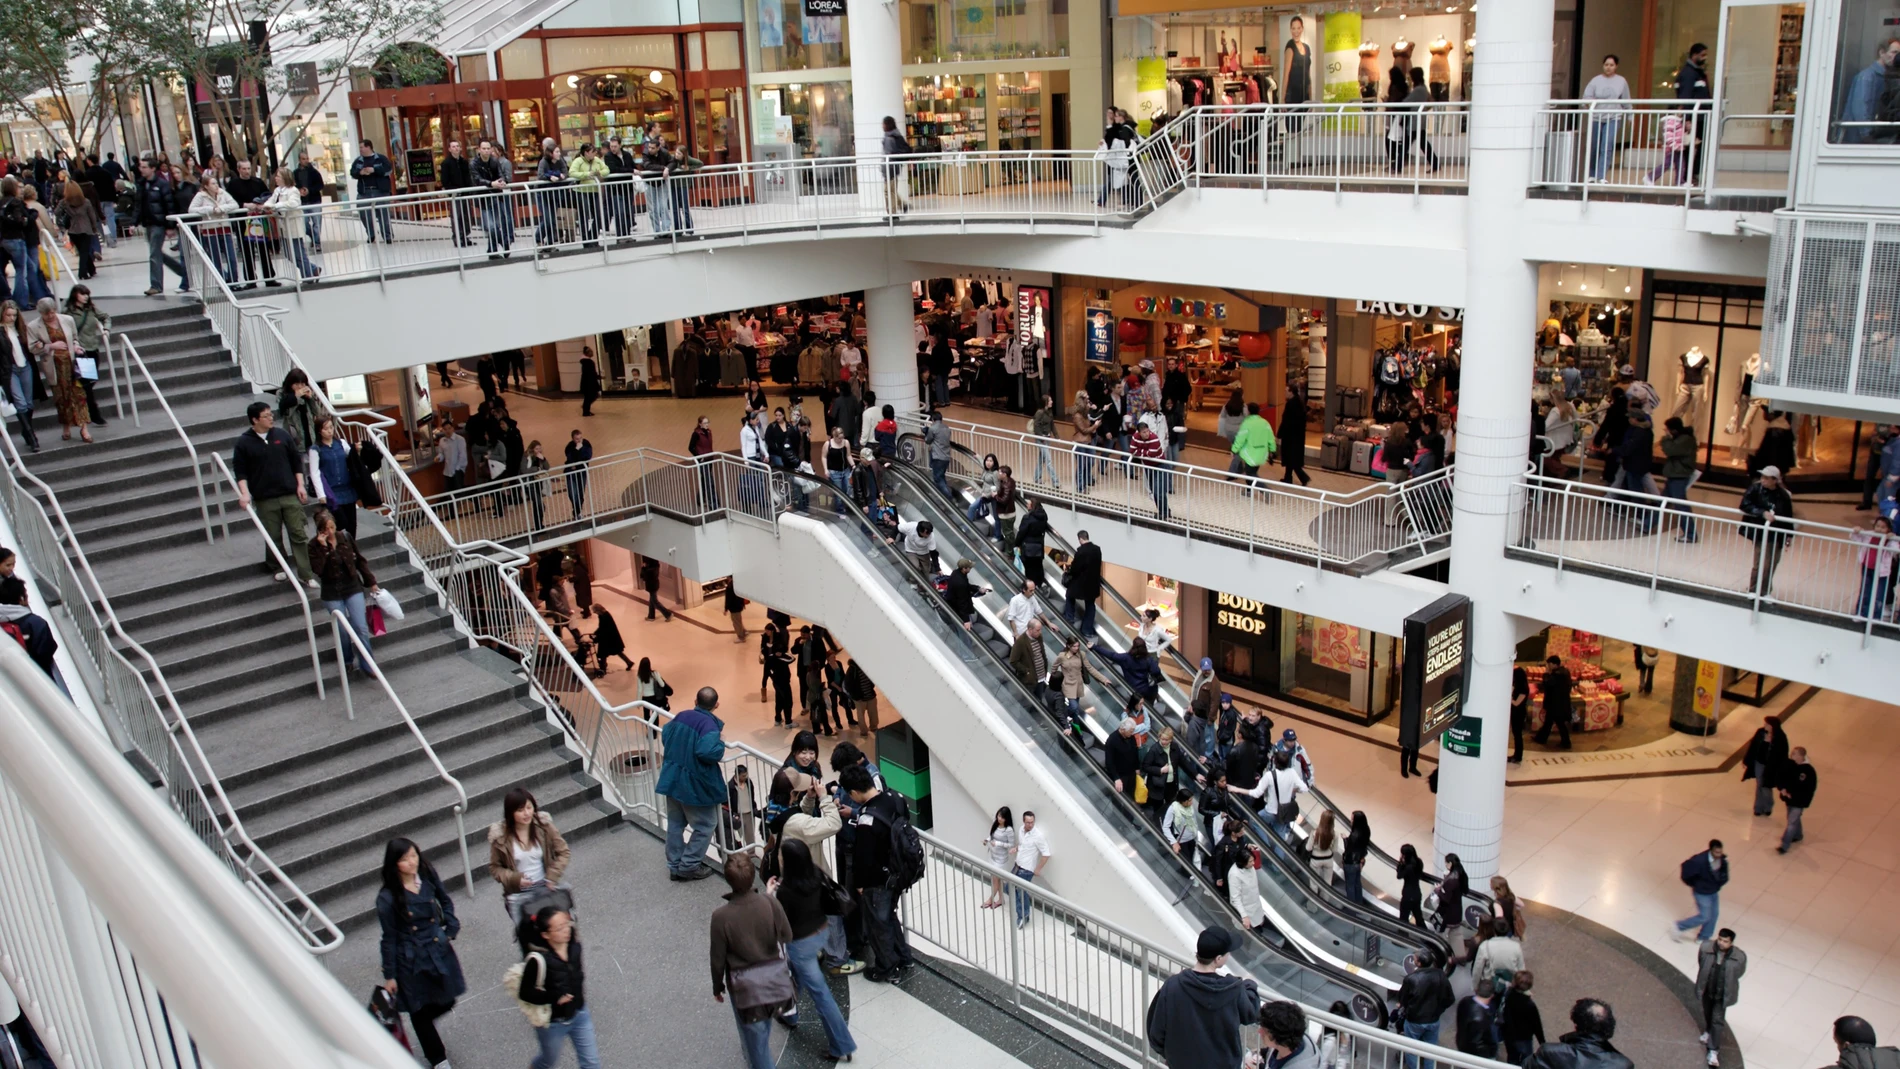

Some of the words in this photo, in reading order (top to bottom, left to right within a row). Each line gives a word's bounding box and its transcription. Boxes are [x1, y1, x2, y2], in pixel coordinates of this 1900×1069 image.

[1135, 296, 1227, 319] GYMBOREE
[1019, 292, 1030, 347] IORUCCI
[906, 451, 911, 460] 2
[1217, 592, 1265, 615] BODY
[1217, 610, 1266, 635] SHOP
[1428, 628, 1449, 648] YOU'RE
[1449, 619, 1463, 637] ONLY
[1426, 640, 1463, 674] ENDLESS
[1527, 756, 1575, 766] THE
[1582, 751, 1636, 763] BODY
[1363, 1007, 1368, 1019] 1
